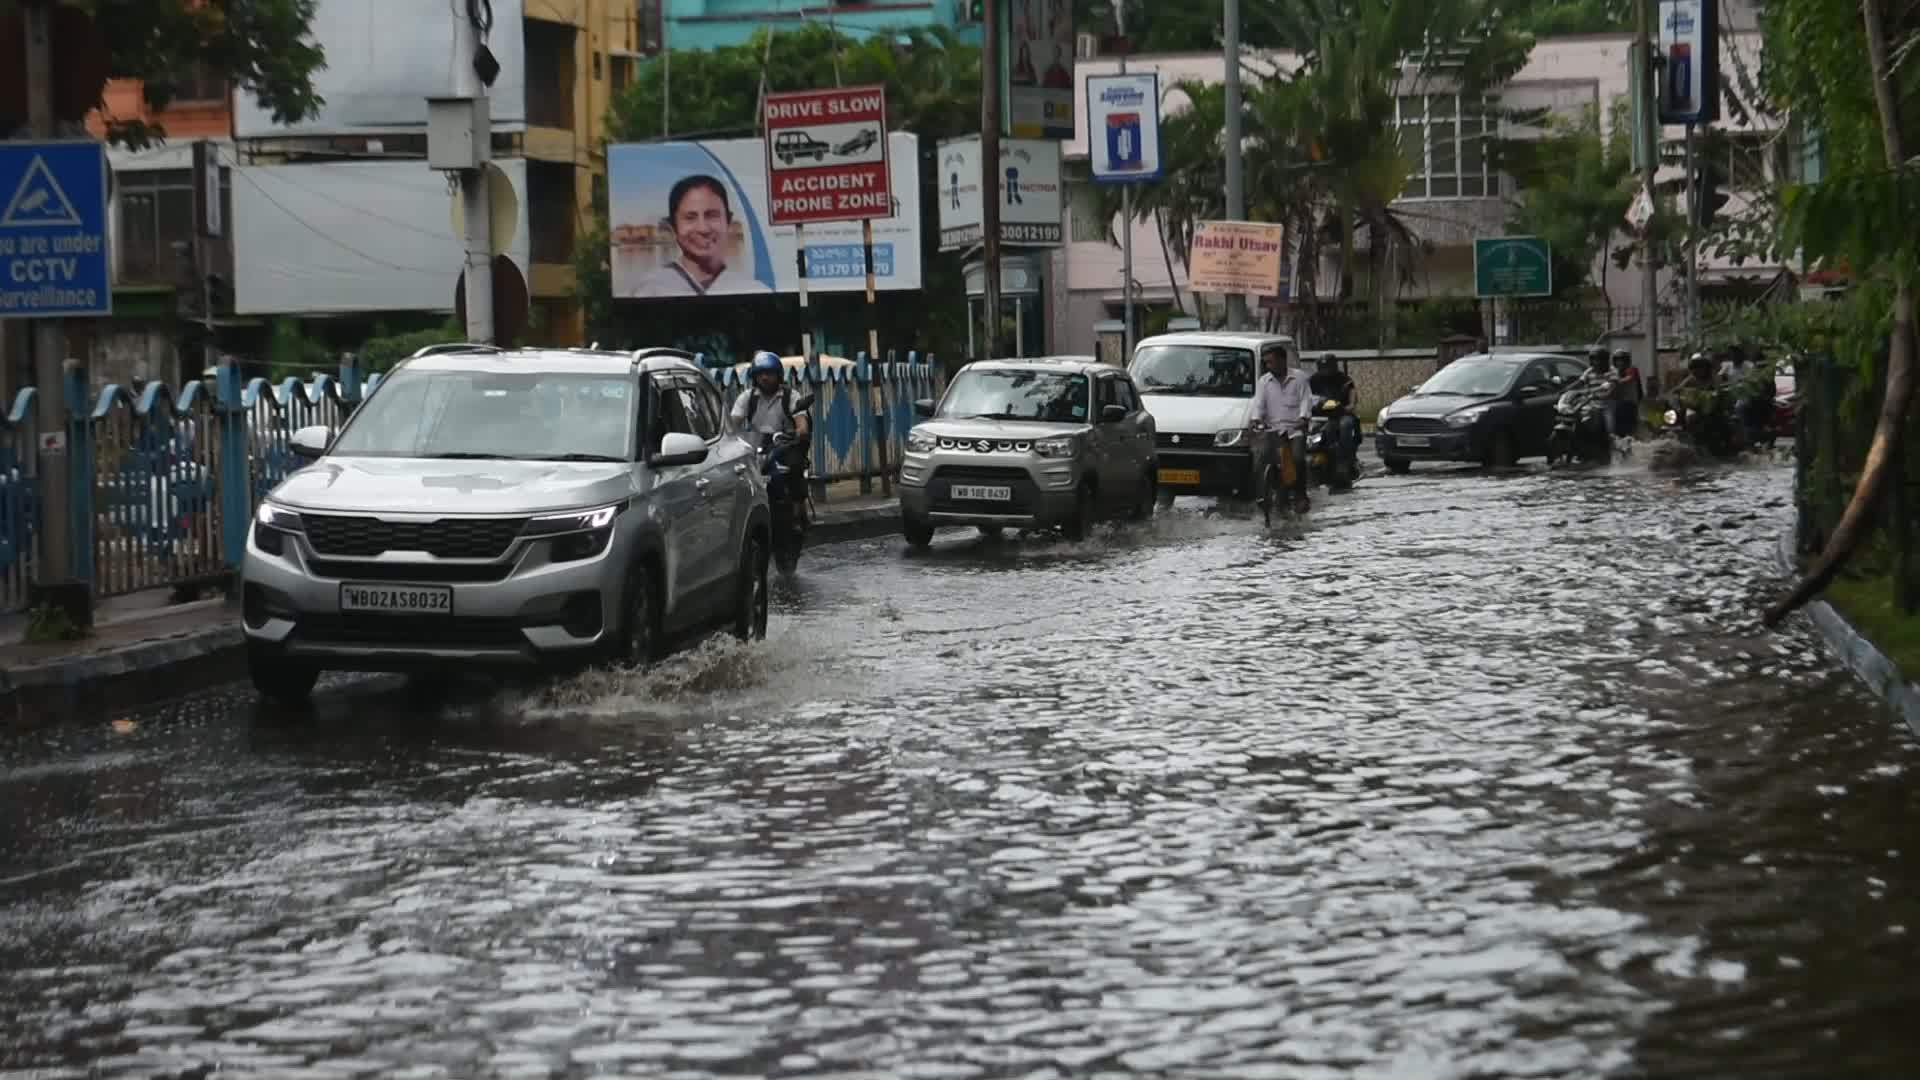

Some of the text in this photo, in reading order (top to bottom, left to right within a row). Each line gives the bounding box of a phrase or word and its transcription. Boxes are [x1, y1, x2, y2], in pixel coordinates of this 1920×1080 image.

[768, 95, 880, 119] DRIVE SLOW
[781, 172, 876, 193] ACCIDENT
[773, 191, 888, 214] PRONE ZONE
[0, 231, 100, 255] ou are under
[1194, 234, 1278, 252] Rakhi Utsav
[11, 257, 79, 283] CCTV
[812, 261, 889, 276] 91370 9170
[350, 588, 449, 609] WB02AS8032
